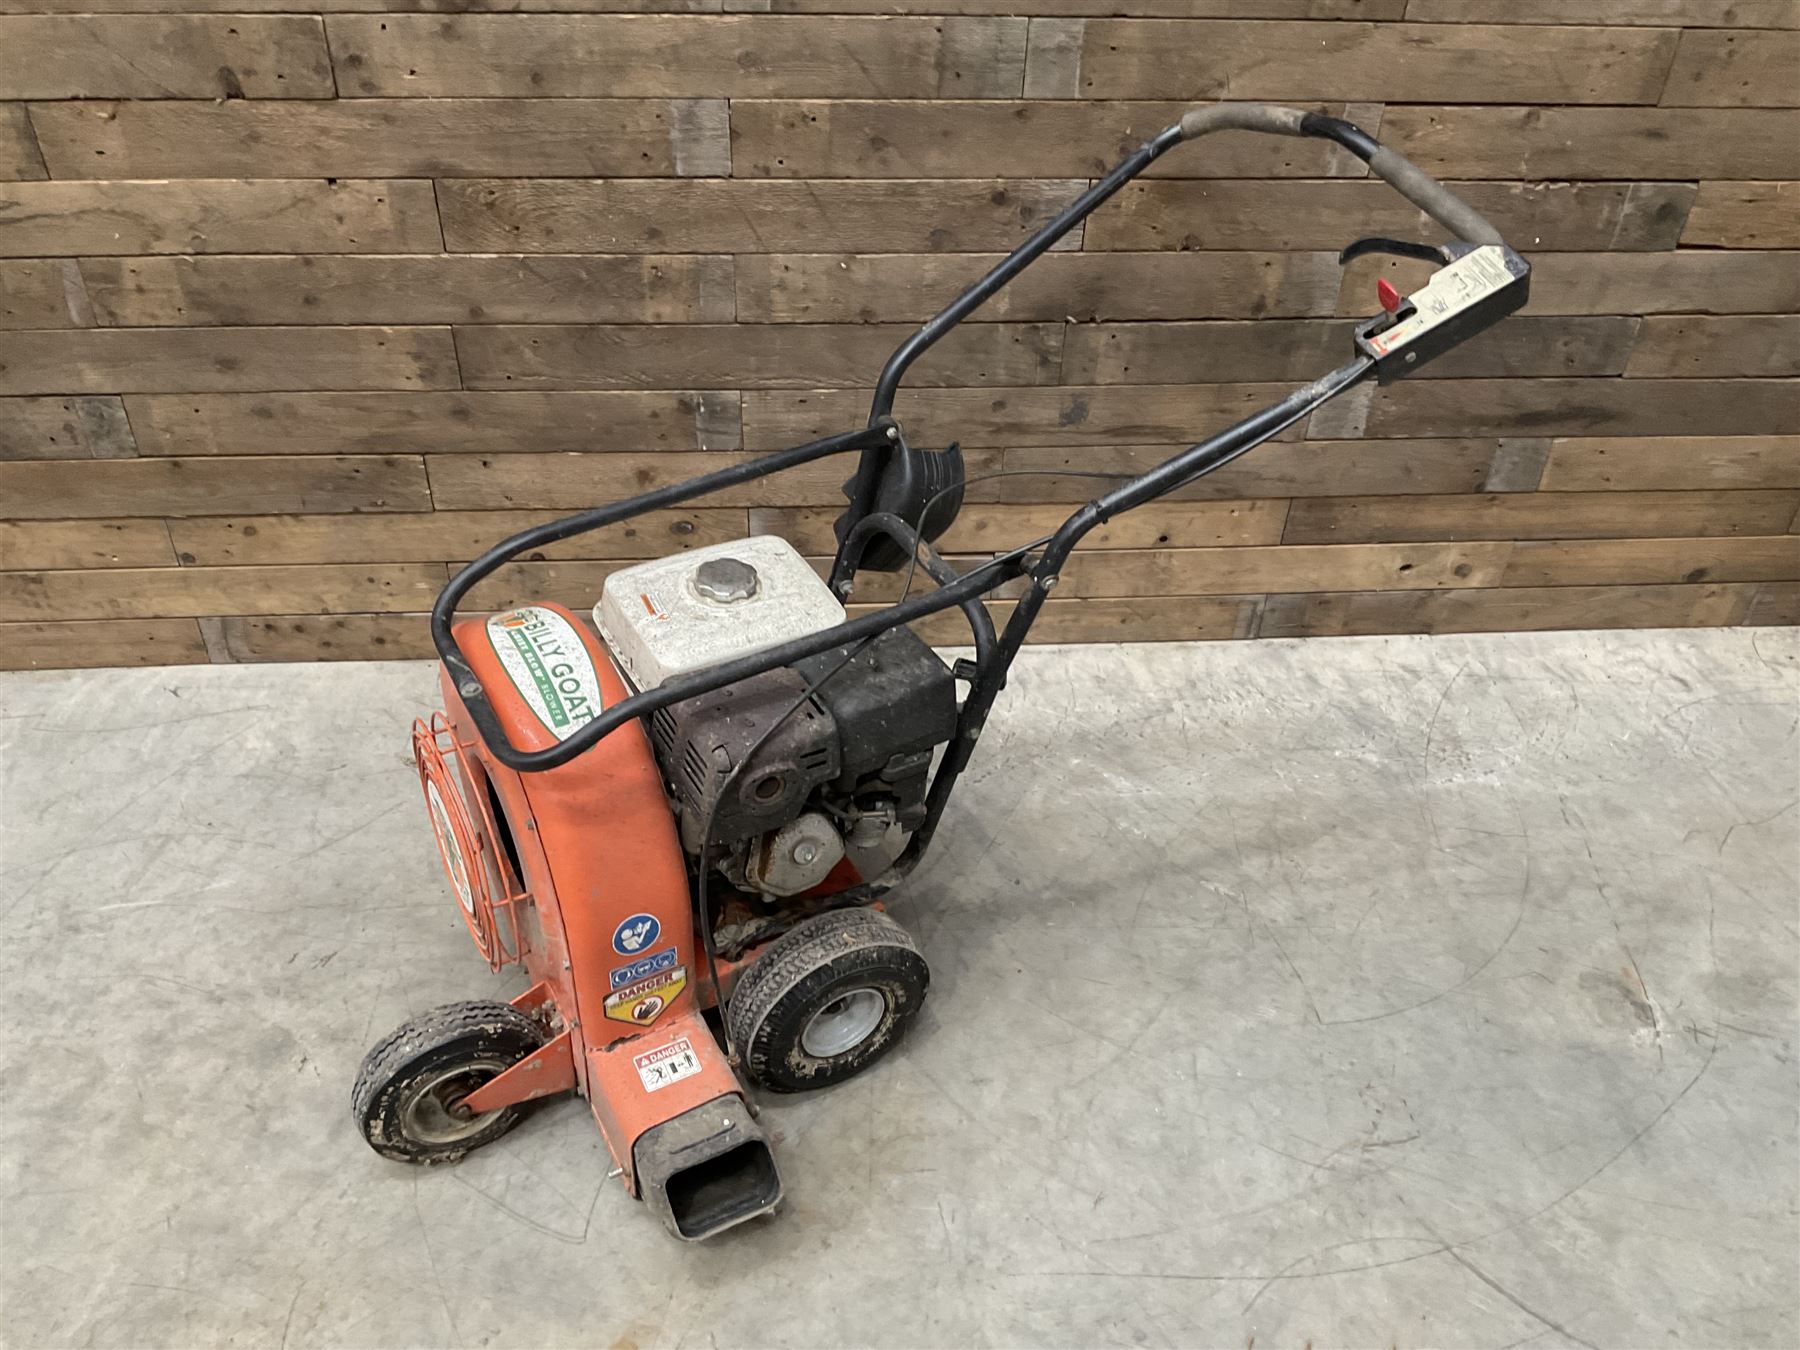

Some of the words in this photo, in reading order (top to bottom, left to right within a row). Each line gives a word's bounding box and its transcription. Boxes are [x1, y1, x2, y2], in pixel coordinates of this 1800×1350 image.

[524, 621, 565, 657] BILLY
[551, 663, 595, 720] GOAT
[618, 973, 673, 1000] DANGER
[650, 1042, 687, 1062] DANGER
